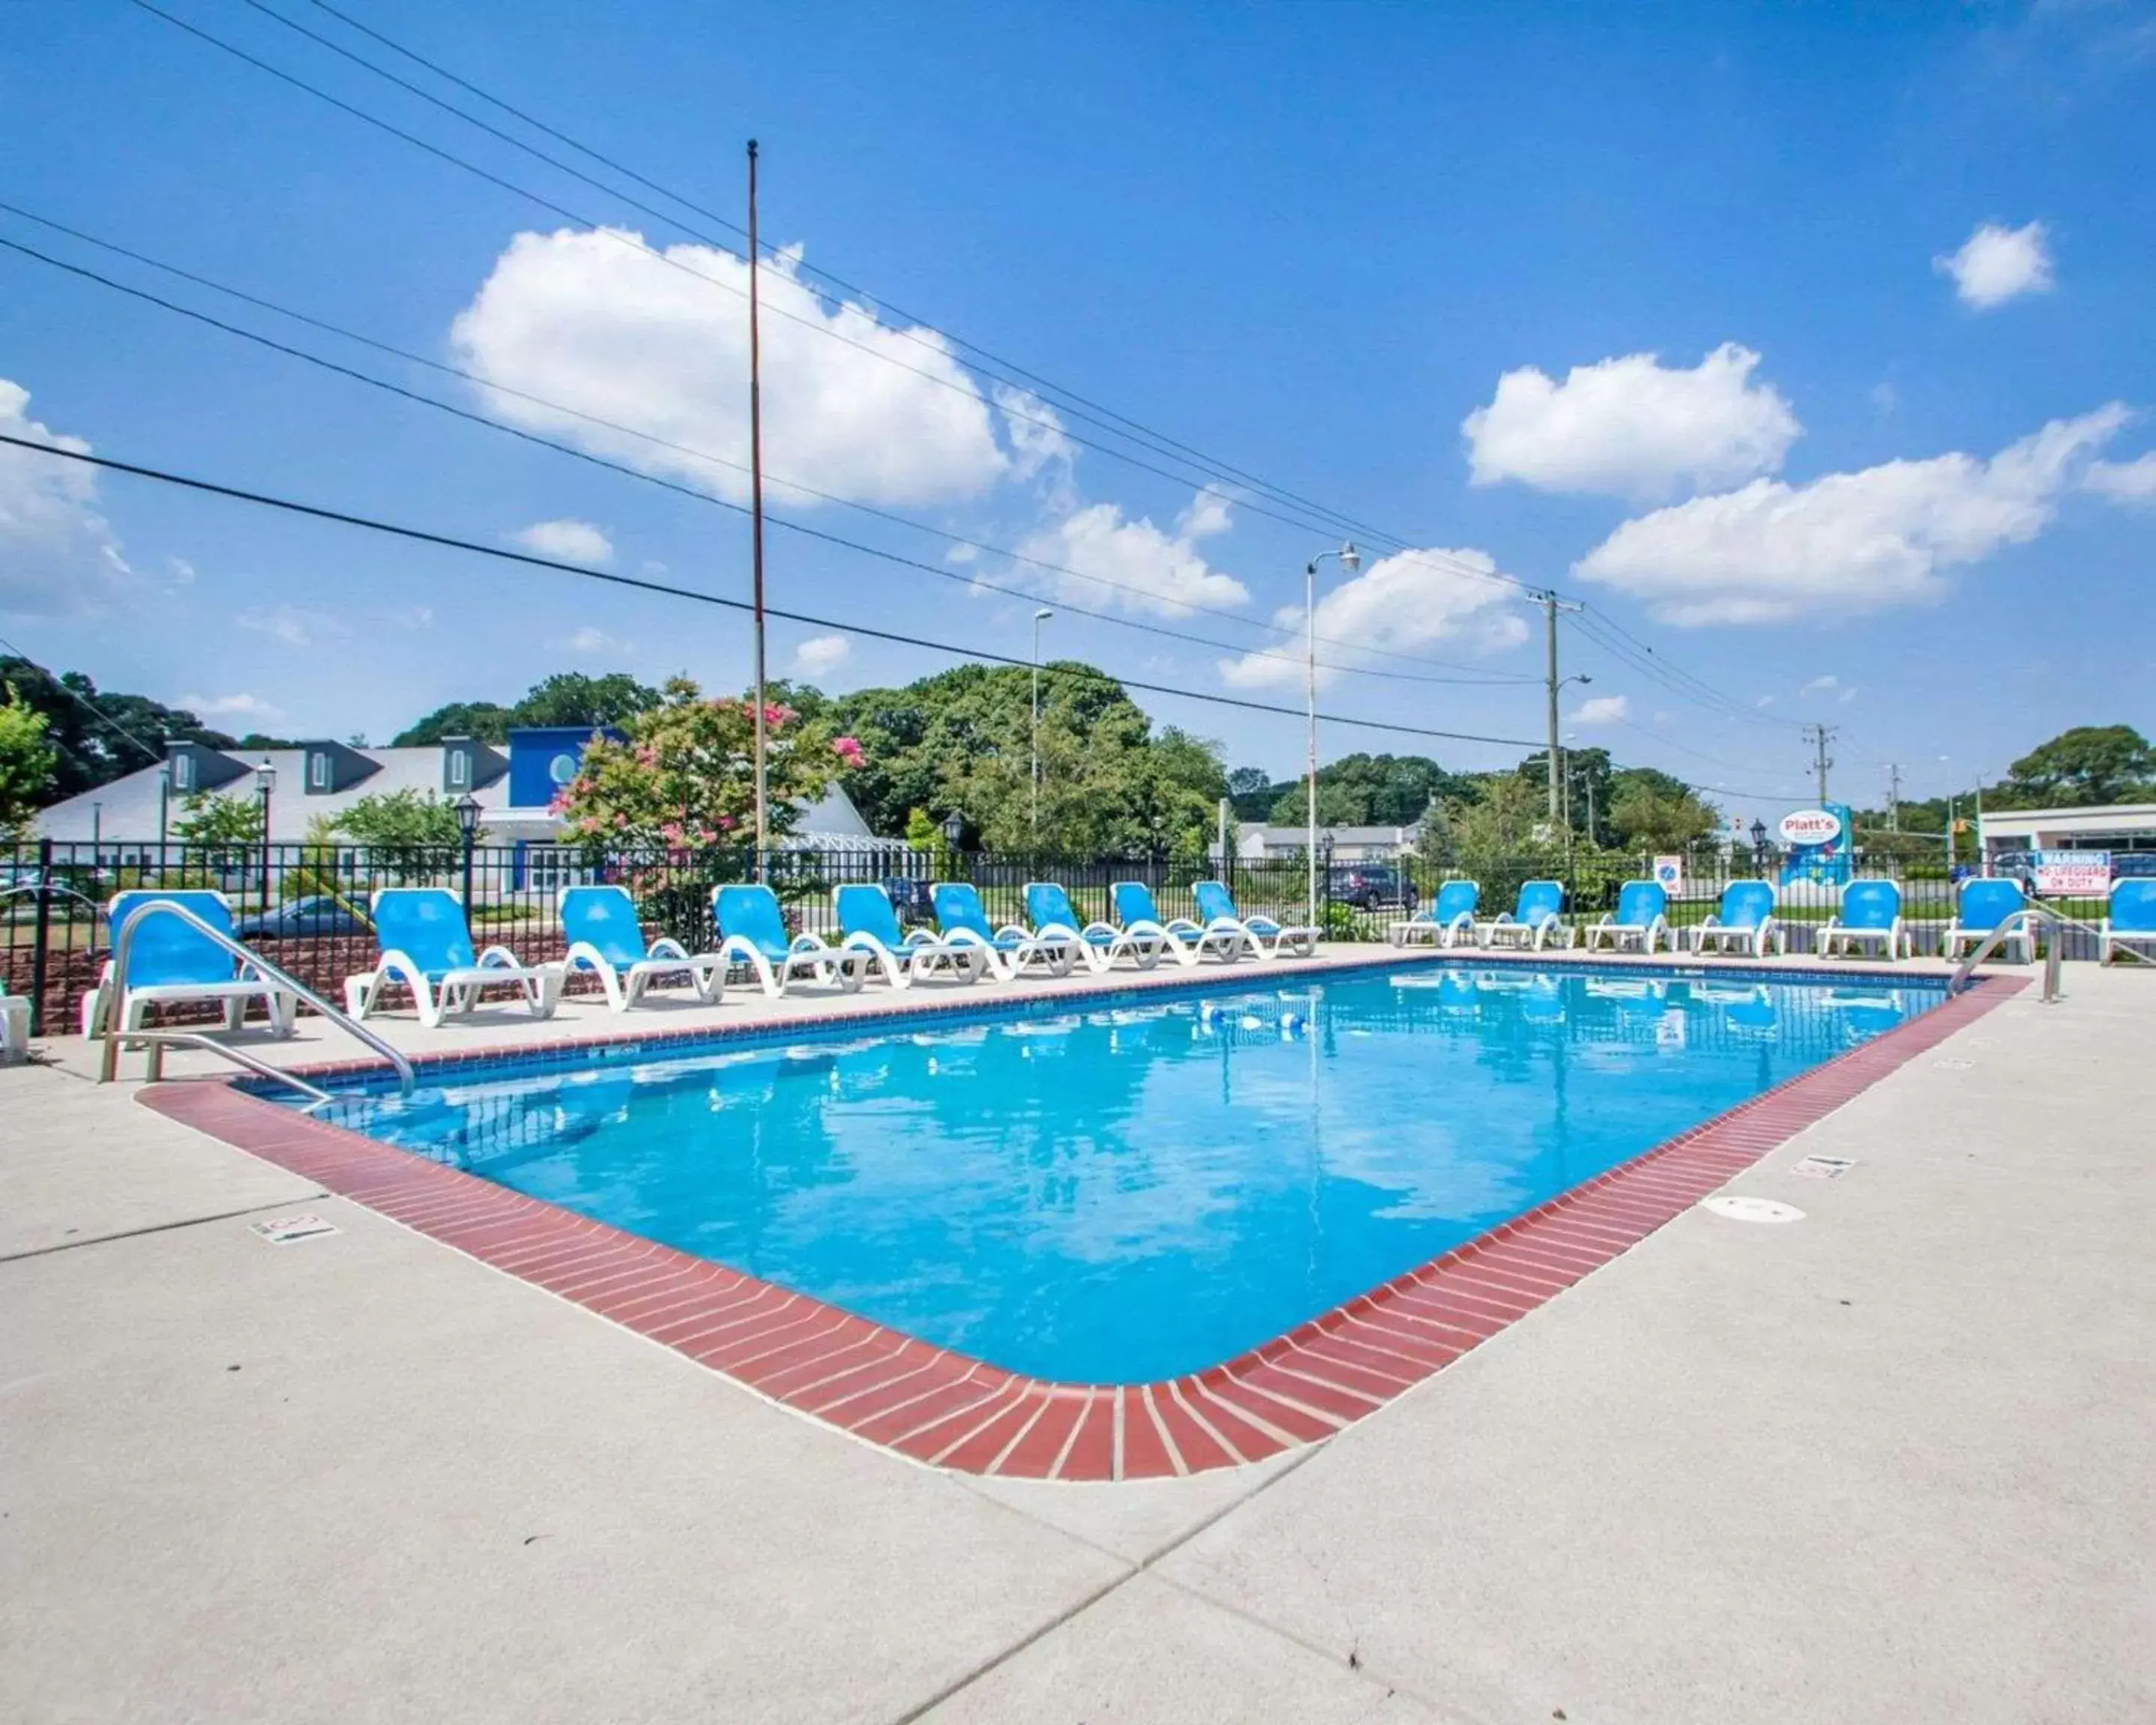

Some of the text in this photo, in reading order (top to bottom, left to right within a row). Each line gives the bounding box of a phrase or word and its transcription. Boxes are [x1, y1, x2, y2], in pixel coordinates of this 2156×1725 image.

[1784, 818, 1834, 830] Platt's
[2050, 877, 2092, 887] ON DUTY
